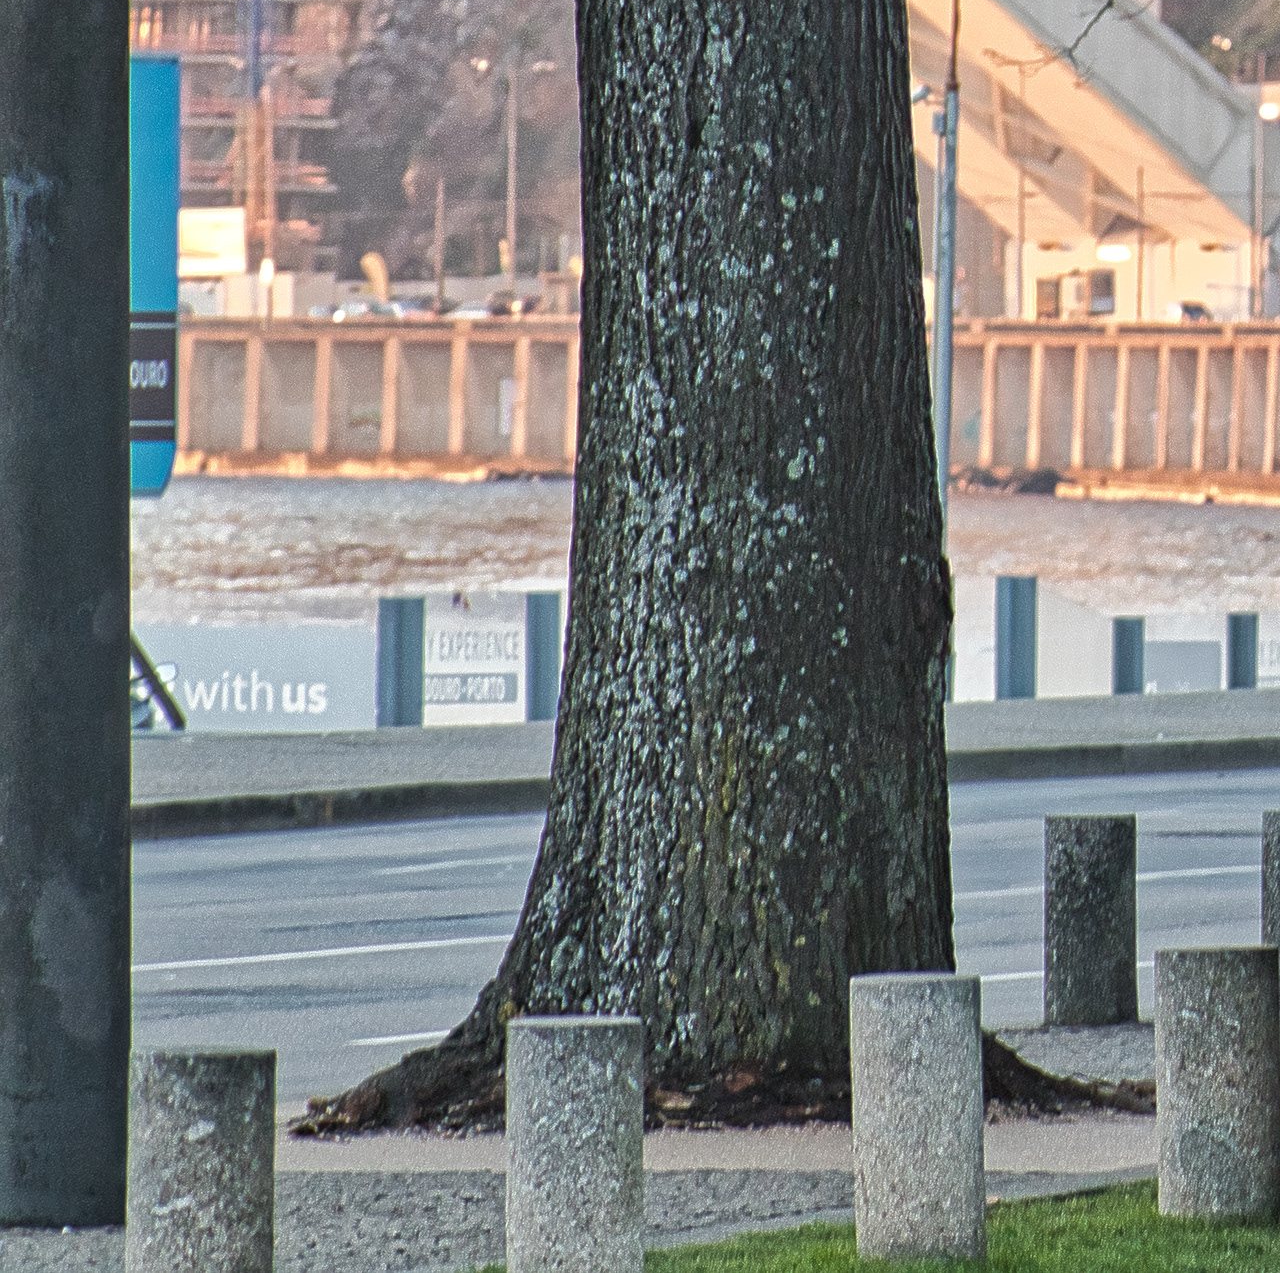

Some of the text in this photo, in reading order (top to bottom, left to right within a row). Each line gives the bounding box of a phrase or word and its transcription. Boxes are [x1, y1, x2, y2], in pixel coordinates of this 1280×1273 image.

[439, 630, 519, 662] EXPERIENCE
[184, 671, 328, 715] with us
